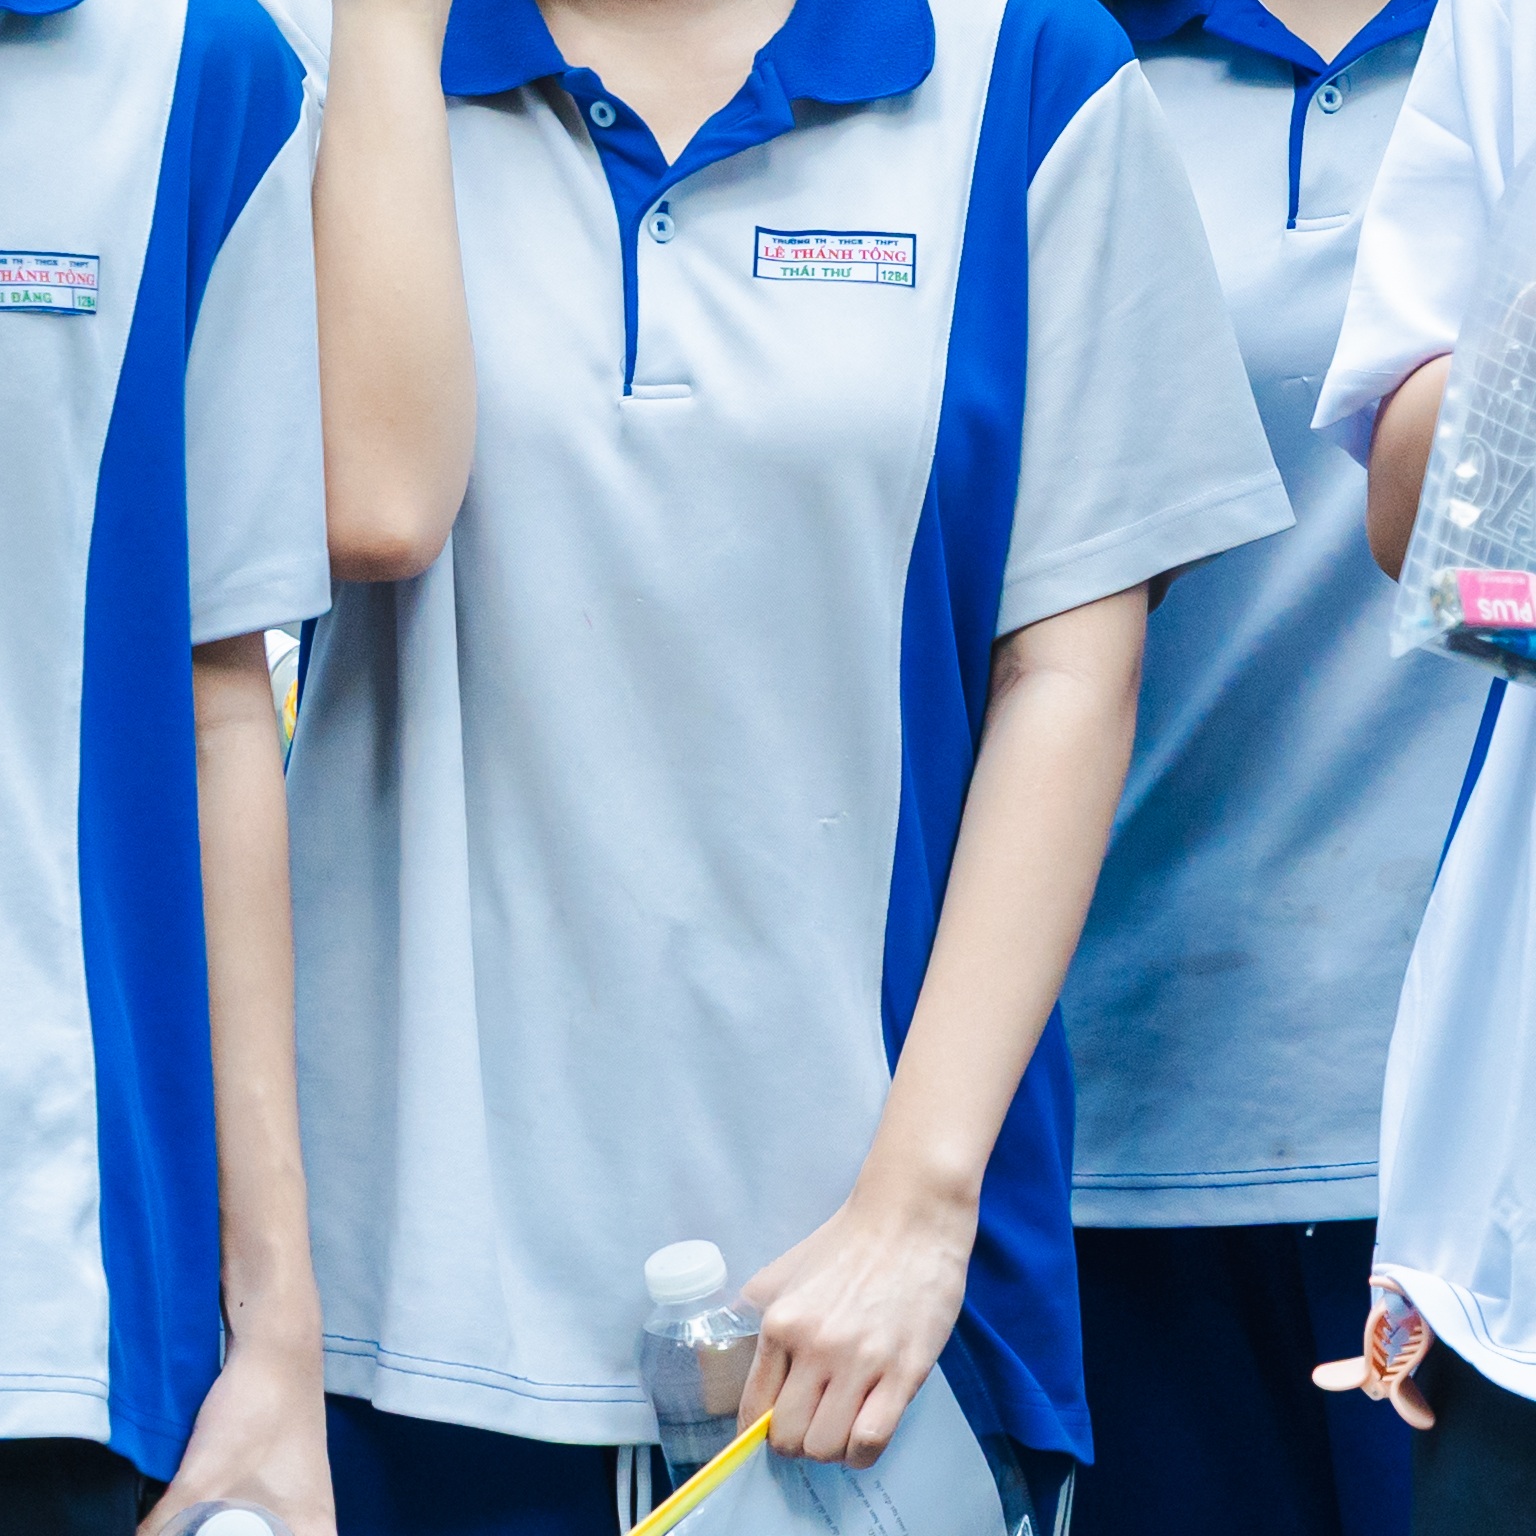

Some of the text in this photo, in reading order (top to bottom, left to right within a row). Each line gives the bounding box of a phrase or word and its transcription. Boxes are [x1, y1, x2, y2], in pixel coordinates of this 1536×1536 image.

[764, 245, 907, 262] LÊ THÁNH TÔNG
[780, 265, 908, 282] THÁI THƯ 12B4
[1477, 598, 1533, 622] PLUS
